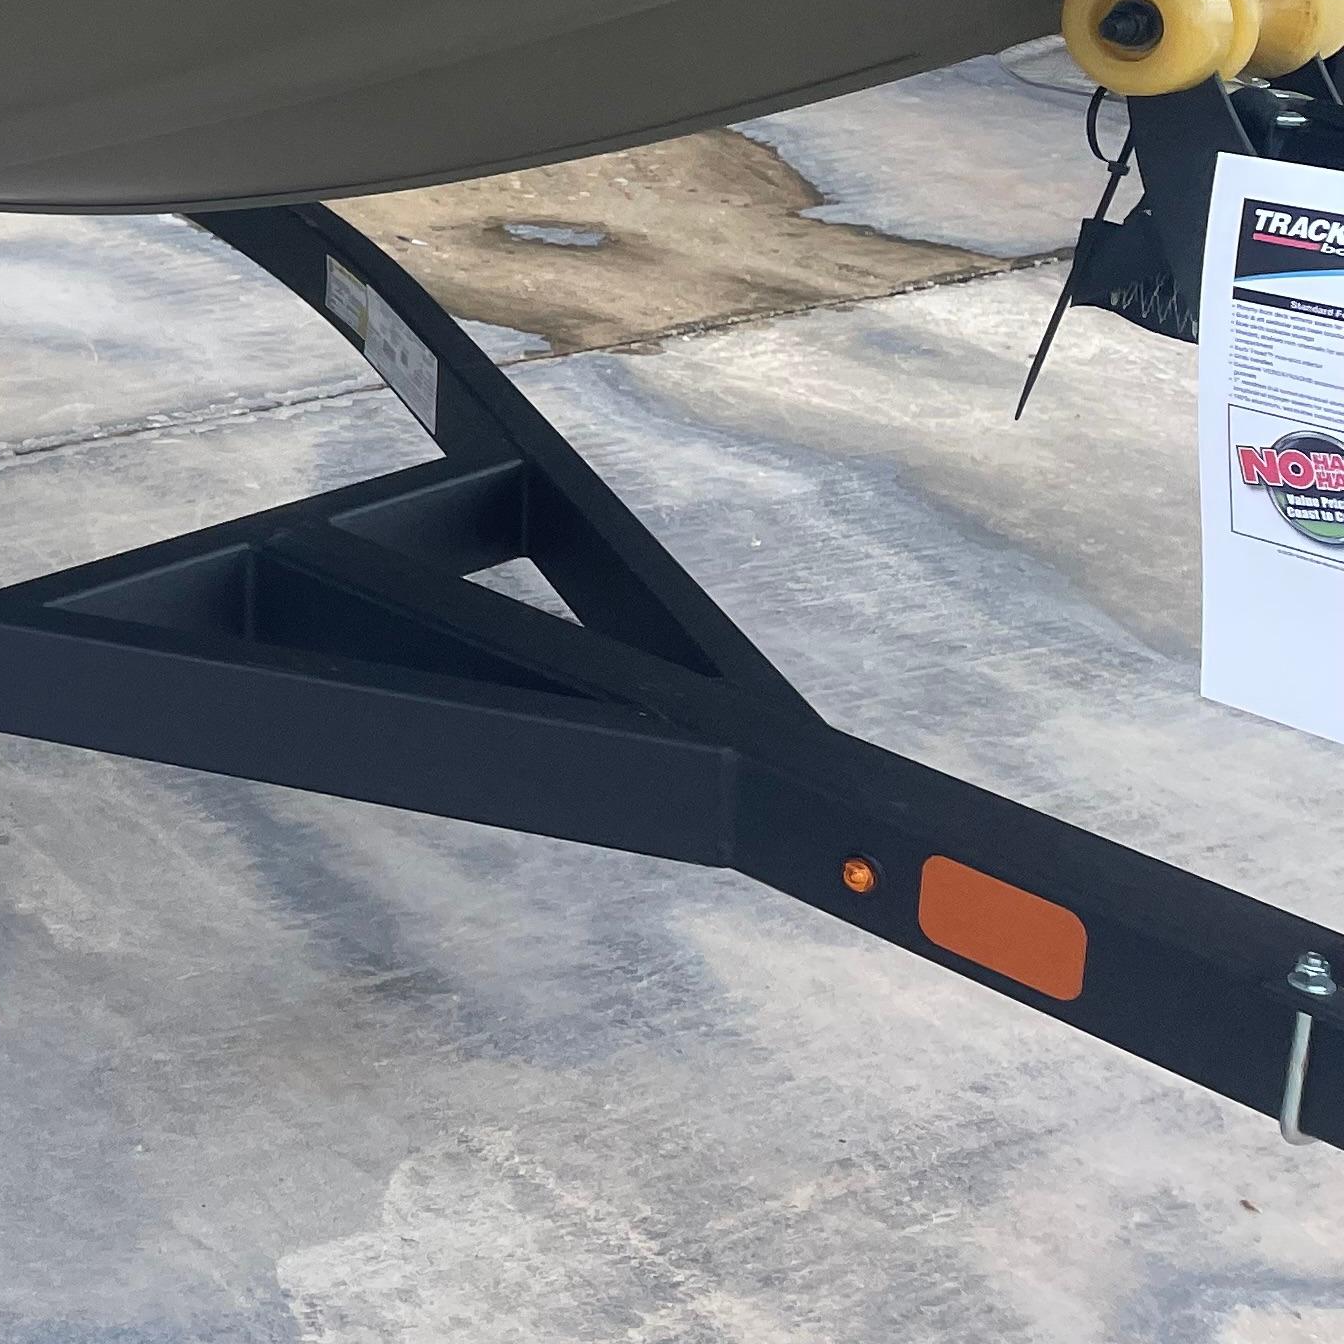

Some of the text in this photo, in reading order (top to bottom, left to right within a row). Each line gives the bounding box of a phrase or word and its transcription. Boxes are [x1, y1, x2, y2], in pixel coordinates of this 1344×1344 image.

[1290, 300, 1334, 317] Standard
[1236, 445, 1315, 490] NO
[1286, 494, 1320, 507] Value
[1286, 506, 1320, 520] Coast
